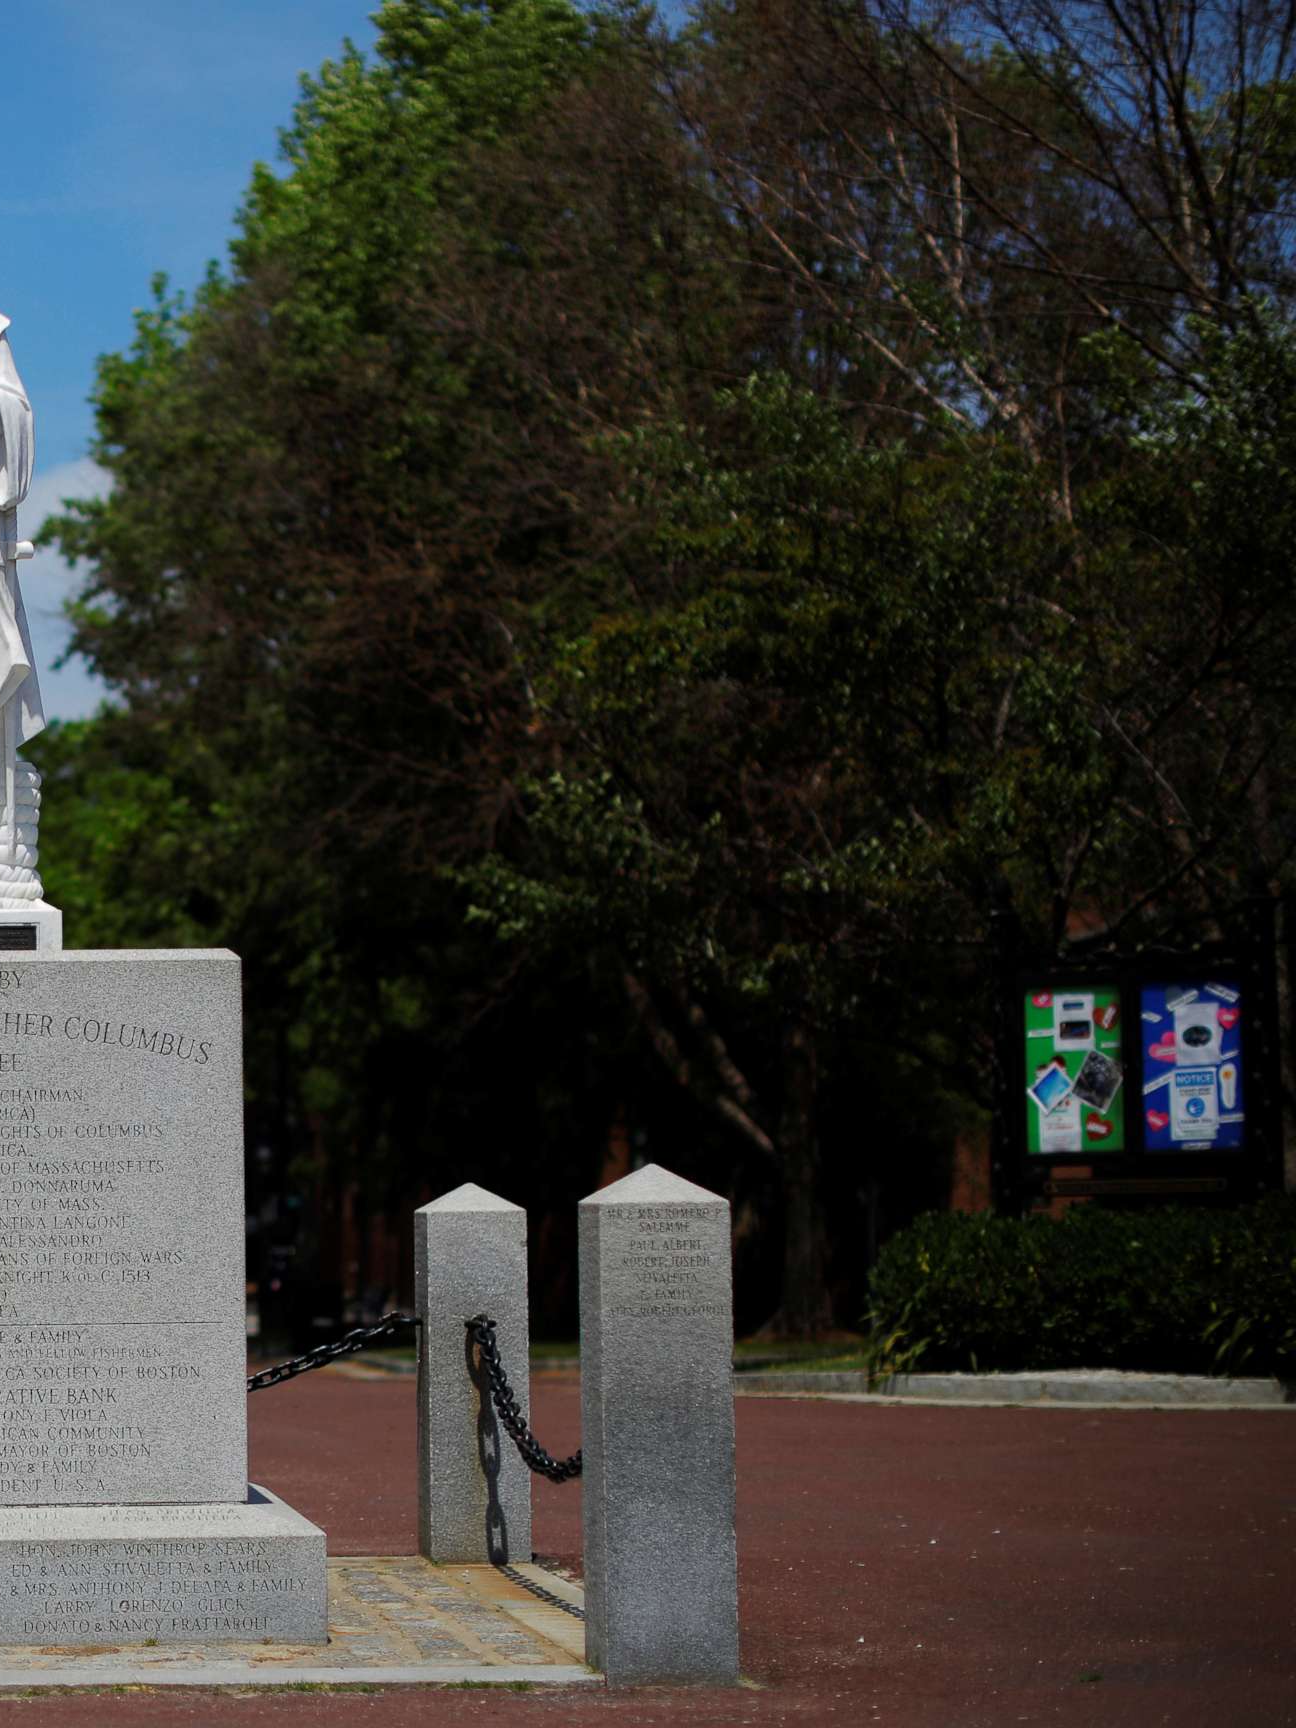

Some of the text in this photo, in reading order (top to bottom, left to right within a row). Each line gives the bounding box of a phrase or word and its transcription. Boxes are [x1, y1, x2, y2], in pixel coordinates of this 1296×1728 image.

[64, 1016, 213, 1065] COLUMBUS
[1177, 1072, 1213, 1085] NOTICE
[0, 1089, 83, 1103] CHAIRMAN
[47, 1125, 66, 1138] OF
[75, 1124, 163, 1138] COLUMBUS
[0, 1162, 20, 1175] OF
[29, 1160, 164, 1174] MASSACHUSETTS
[12, 1180, 114, 1194] DONNARUMA
[31, 1199, 50, 1211] OF
[59, 1198, 105, 1212] MASS.
[36, 1253, 55, 1266] OF
[63, 1252, 131, 1265] FOREIGN
[141, 1252, 183, 1265] WARS
[121, 1270, 151, 1283] 1513
[14, 1334, 22, 1344] &
[30, 1331, 85, 1344] FAMILY
[34, 1366, 101, 1381] SOCIETY
[108, 1366, 128, 1380] OF
[137, 1365, 201, 1380] BOSTON
[67, 1388, 119, 1404] BANK
[48, 1426, 145, 1440] COMMUNITY
[58, 1444, 77, 1457] OF
[88, 1444, 152, 1457] BOSTON
[27, 1463, 35, 1473] &
[42, 1460, 97, 1474] FAMILY
[70, 1542, 267, 1557] JOHN WINTHROP SEARS
[11, 1560, 274, 1578] ED & ANN & FAMILY
[10, 1578, 307, 1595] & ANTHONY & FAMILY
[43, 1600, 97, 1614] LARRY
[24, 1619, 163, 1634] DONATO & NANCY
